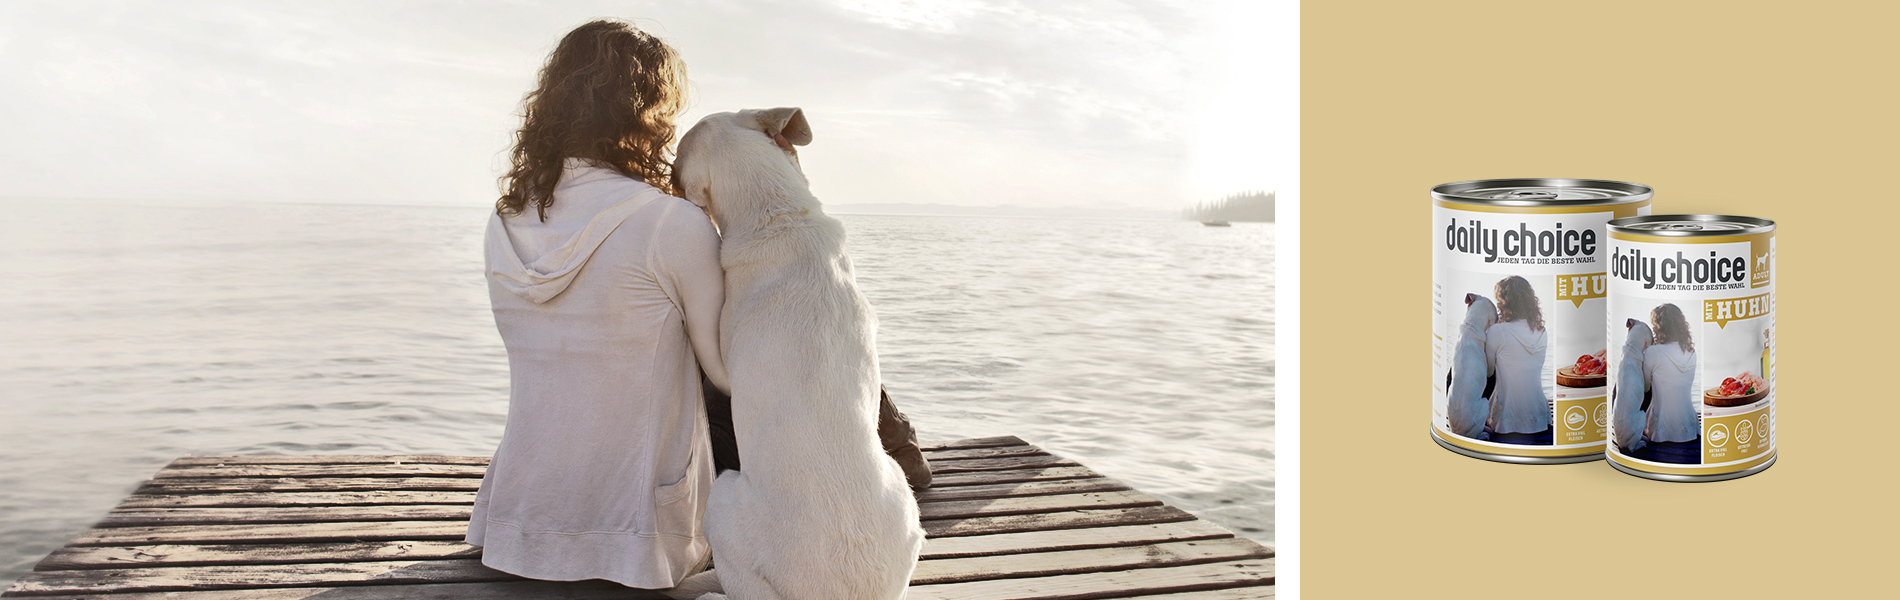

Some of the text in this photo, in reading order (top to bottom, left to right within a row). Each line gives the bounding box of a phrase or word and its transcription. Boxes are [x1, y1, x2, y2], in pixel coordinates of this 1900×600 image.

[1446, 218, 1596, 263] daily choice
[1521, 257, 1536, 265] TAG
[1551, 257, 1575, 265] BESTE
[1611, 246, 1746, 289] daily choice
[1752, 271, 1770, 280] ADULT
[1558, 277, 1567, 297] MIT
[1705, 283, 1727, 291] BESTE
[1728, 282, 1745, 290] WAHL
[1705, 302, 1713, 321] MIT
[1716, 294, 1770, 320] HUHN
